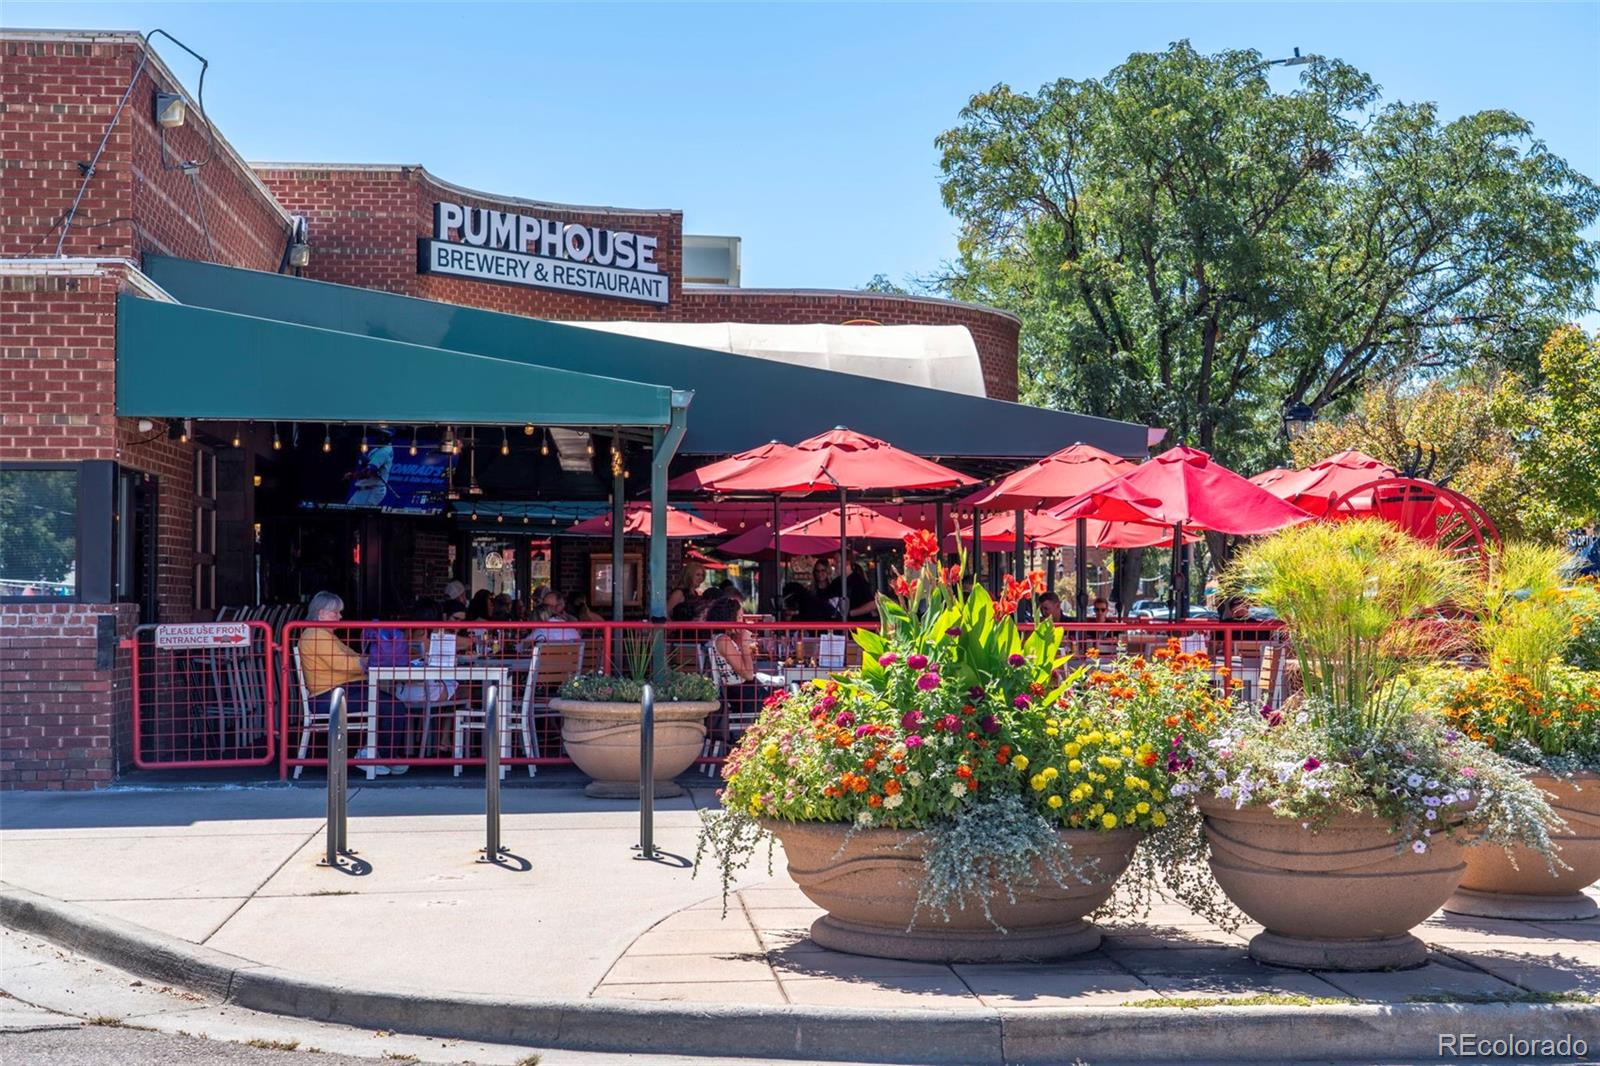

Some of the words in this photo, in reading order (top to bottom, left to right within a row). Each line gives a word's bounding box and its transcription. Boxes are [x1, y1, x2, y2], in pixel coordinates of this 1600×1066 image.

[437, 202, 659, 273] PUMPHOUSE
[437, 248, 530, 278] BREWERY
[534, 264, 549, 282] &
[553, 265, 662, 297] RESTAURANT
[391, 463, 444, 477] ONRAD'S
[160, 627, 194, 635] PLEASE
[196, 627, 214, 635] USE
[216, 626, 246, 634] FRONT
[160, 636, 209, 645] ENTRANCE
